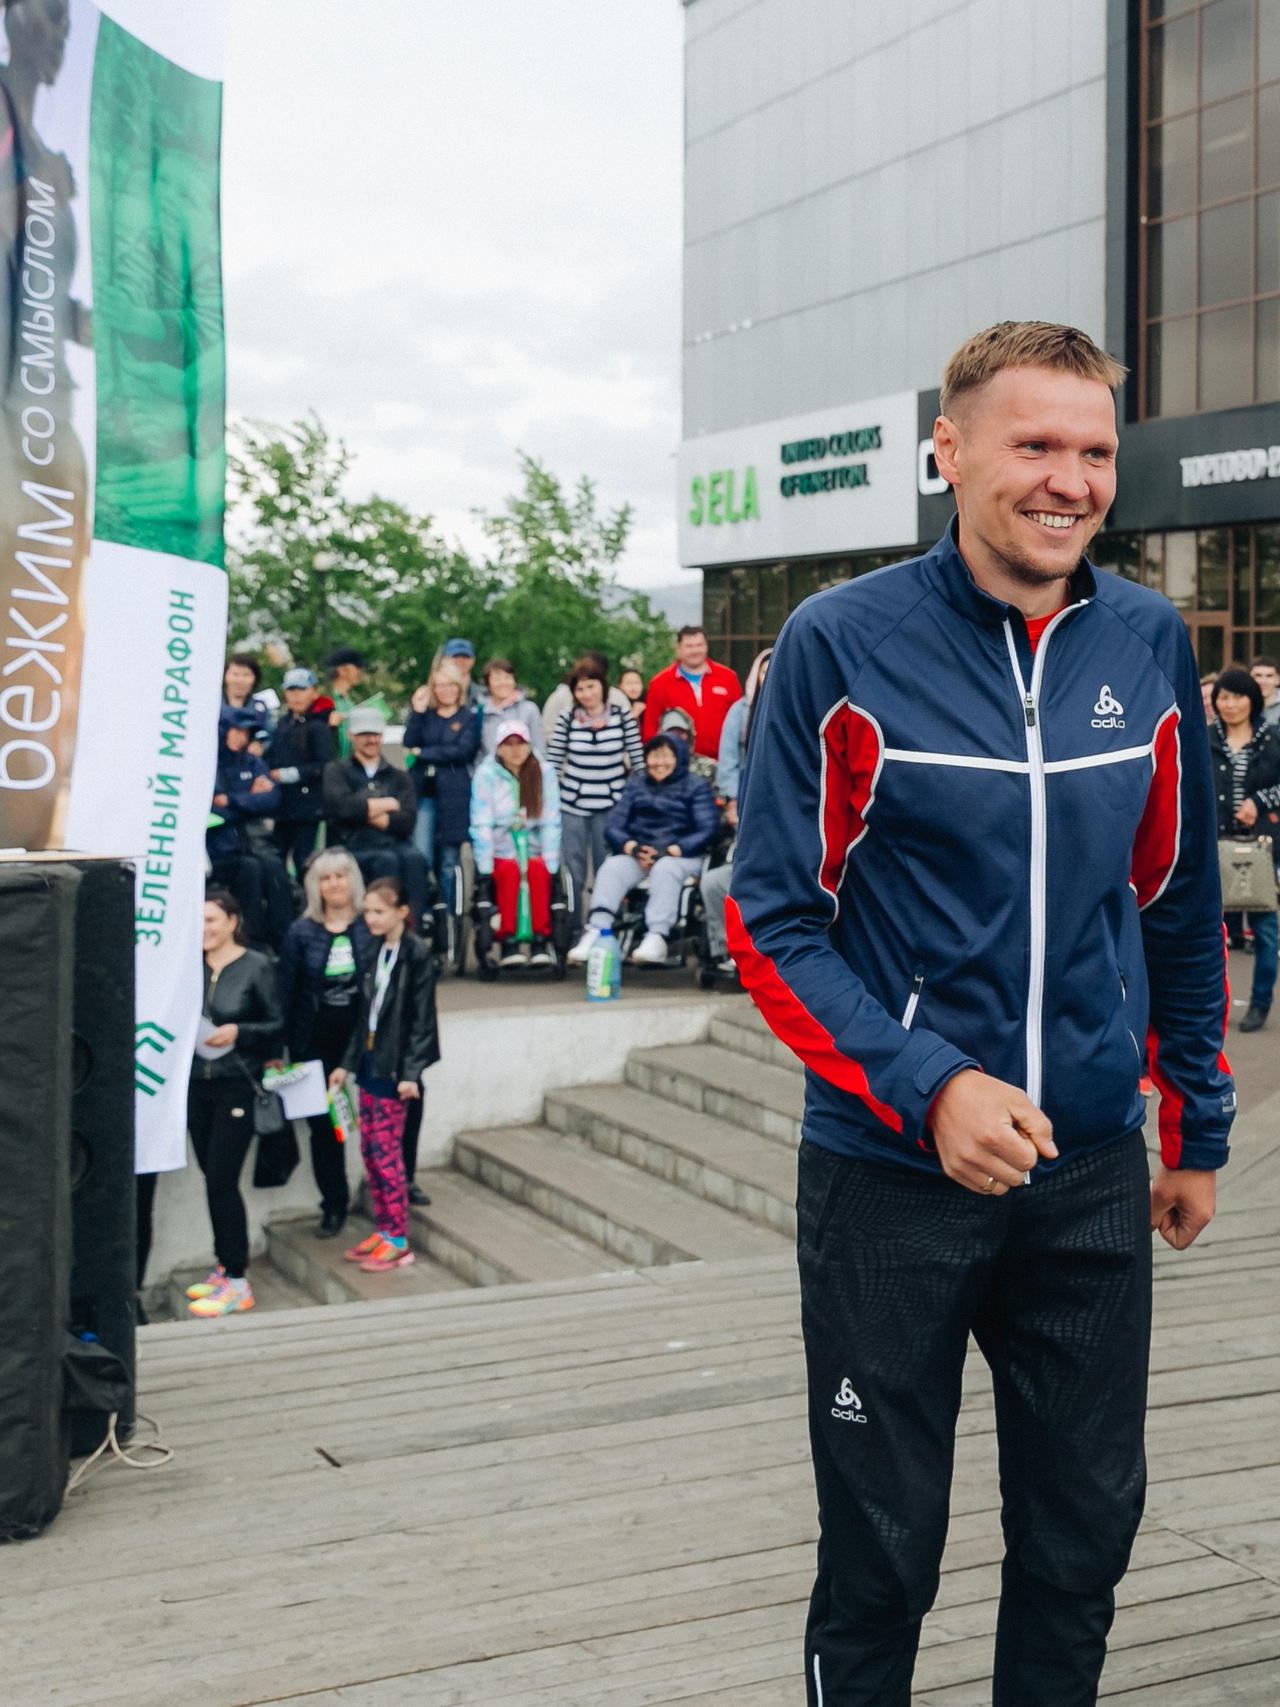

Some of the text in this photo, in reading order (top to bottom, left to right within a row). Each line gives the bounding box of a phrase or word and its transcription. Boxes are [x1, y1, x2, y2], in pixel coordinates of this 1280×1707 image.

[689, 465, 760, 526] SELA
[1091, 716, 1126, 729] odlo
[135, 590, 195, 947] ЗЕЛЕНЫЙ МАРАФОН
[831, 1407, 867, 1424] odlo
